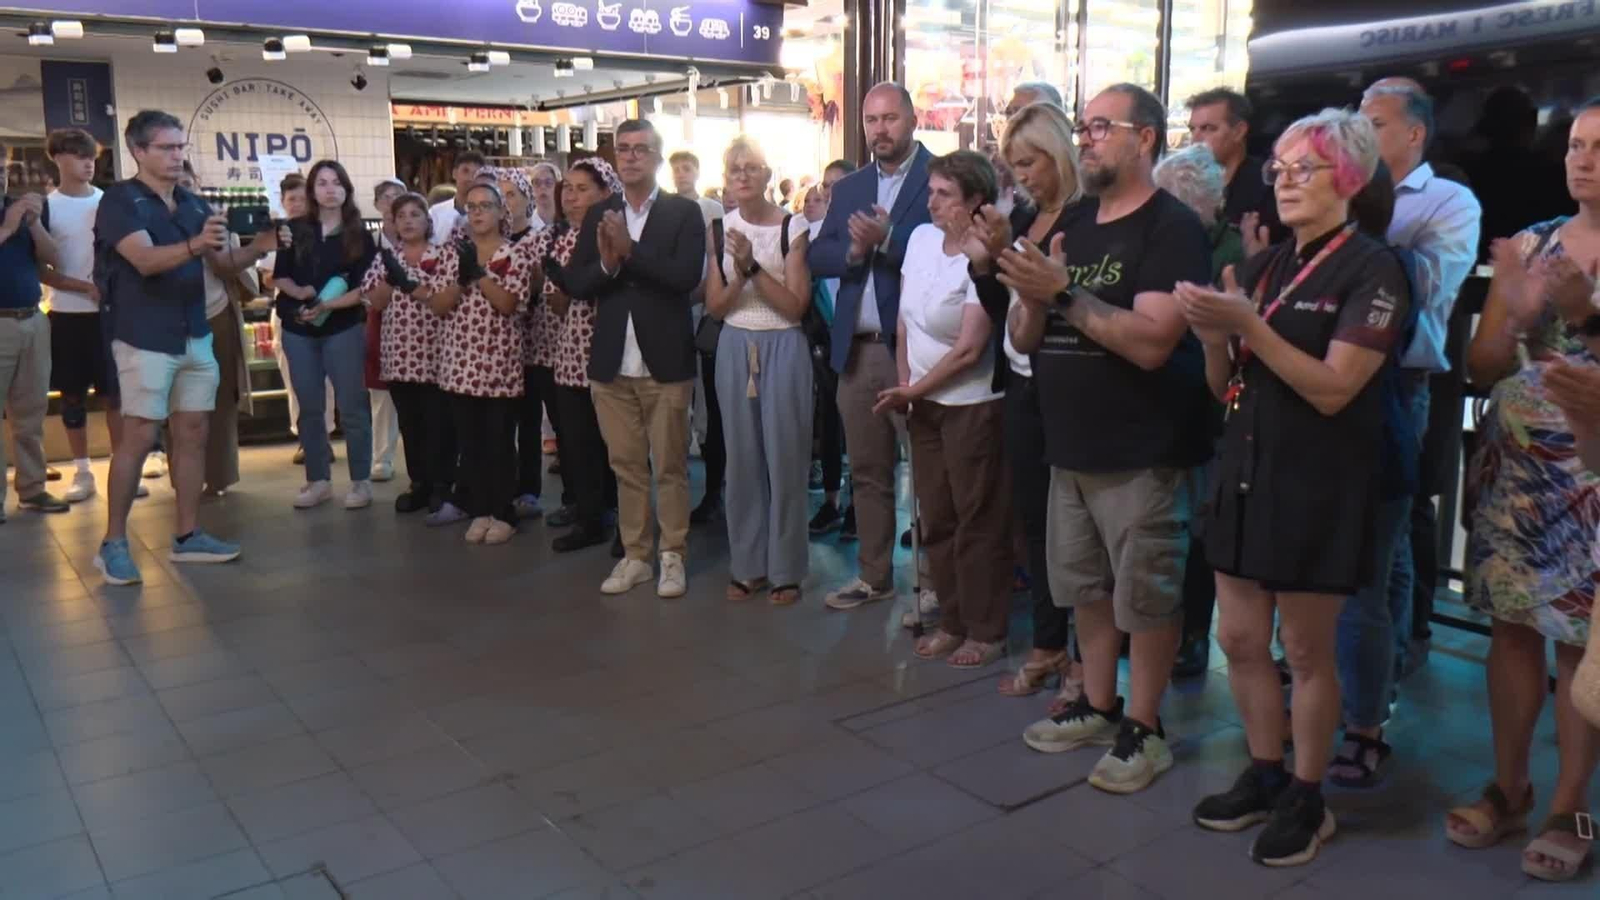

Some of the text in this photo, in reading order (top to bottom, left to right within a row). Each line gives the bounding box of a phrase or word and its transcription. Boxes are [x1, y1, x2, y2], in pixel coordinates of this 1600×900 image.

[753, 25, 770, 40] 39
[200, 83, 322, 124] SUSHI BAR TAKE AWAY
[215, 128, 312, 162] NIPŌ
